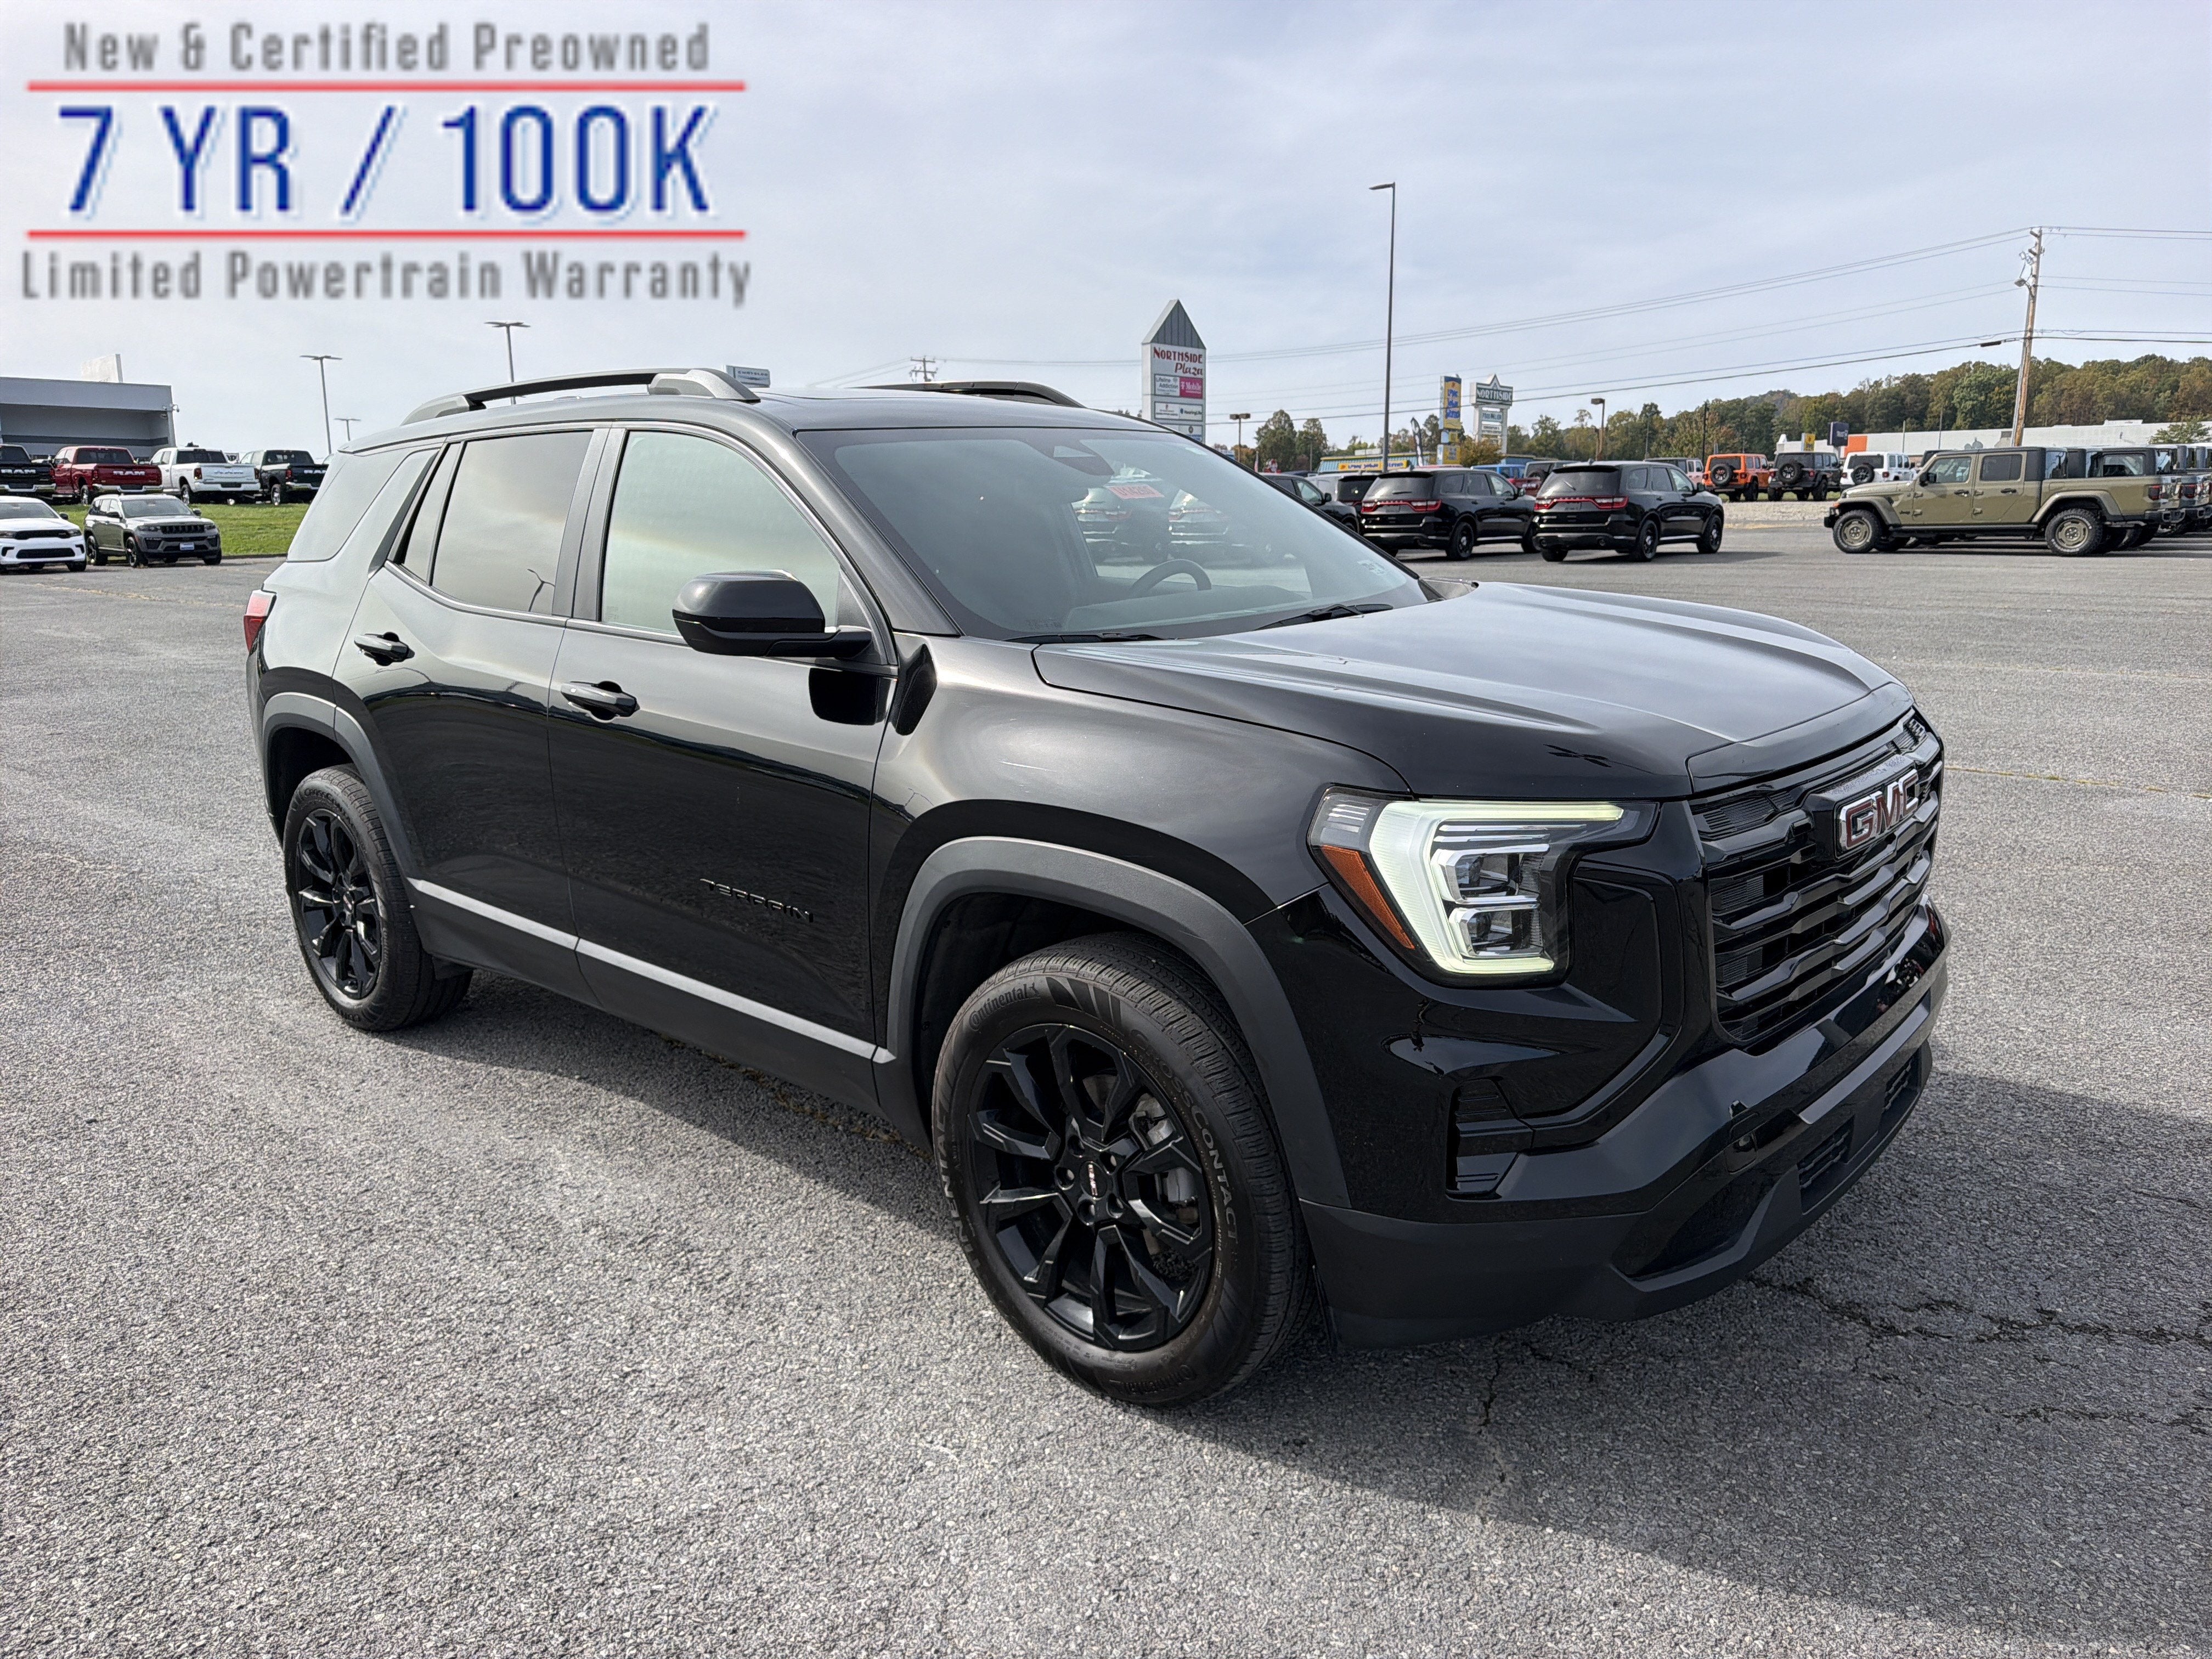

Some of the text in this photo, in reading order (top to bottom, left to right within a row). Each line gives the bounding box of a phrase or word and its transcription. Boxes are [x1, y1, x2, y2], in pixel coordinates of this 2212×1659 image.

[1153, 346, 1203, 364] NORTHSIDE
[1175, 362, 1203, 376] Plaza
[1477, 388, 1512, 402] NORTHSIDE
[1839, 769, 1919, 850] GMC
[968, 983, 1029, 1031] Continental
